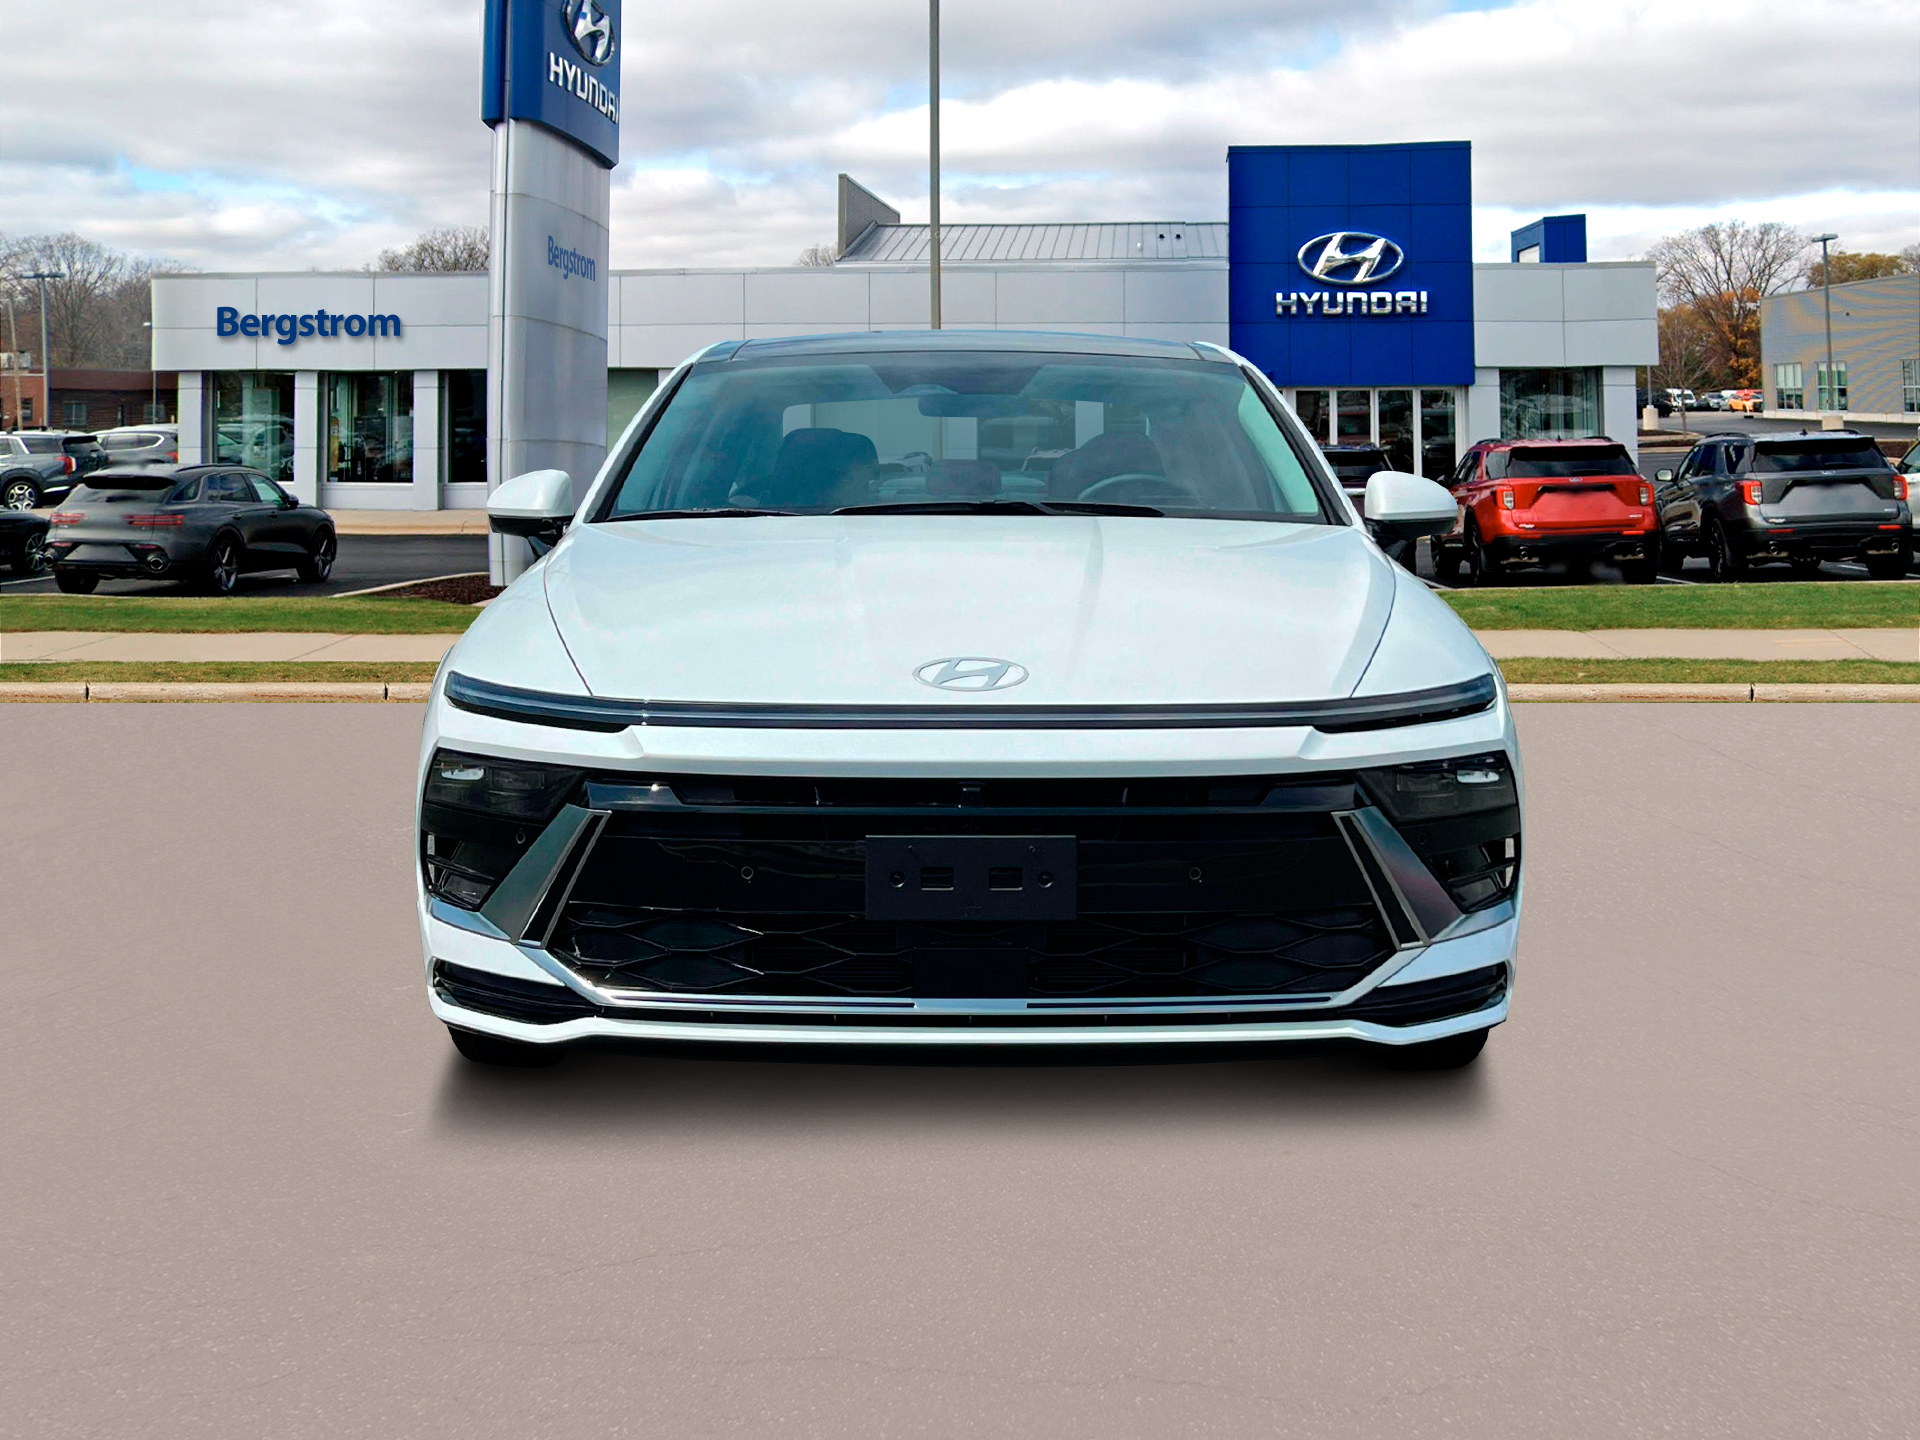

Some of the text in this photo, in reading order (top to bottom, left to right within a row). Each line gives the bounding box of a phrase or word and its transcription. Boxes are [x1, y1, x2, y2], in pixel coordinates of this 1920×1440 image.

[549, 52, 619, 124] HYUNDAI
[547, 235, 596, 282] Bergstrom
[1275, 291, 1428, 315] HYUNDAI
[217, 306, 401, 346] Bergstrom
